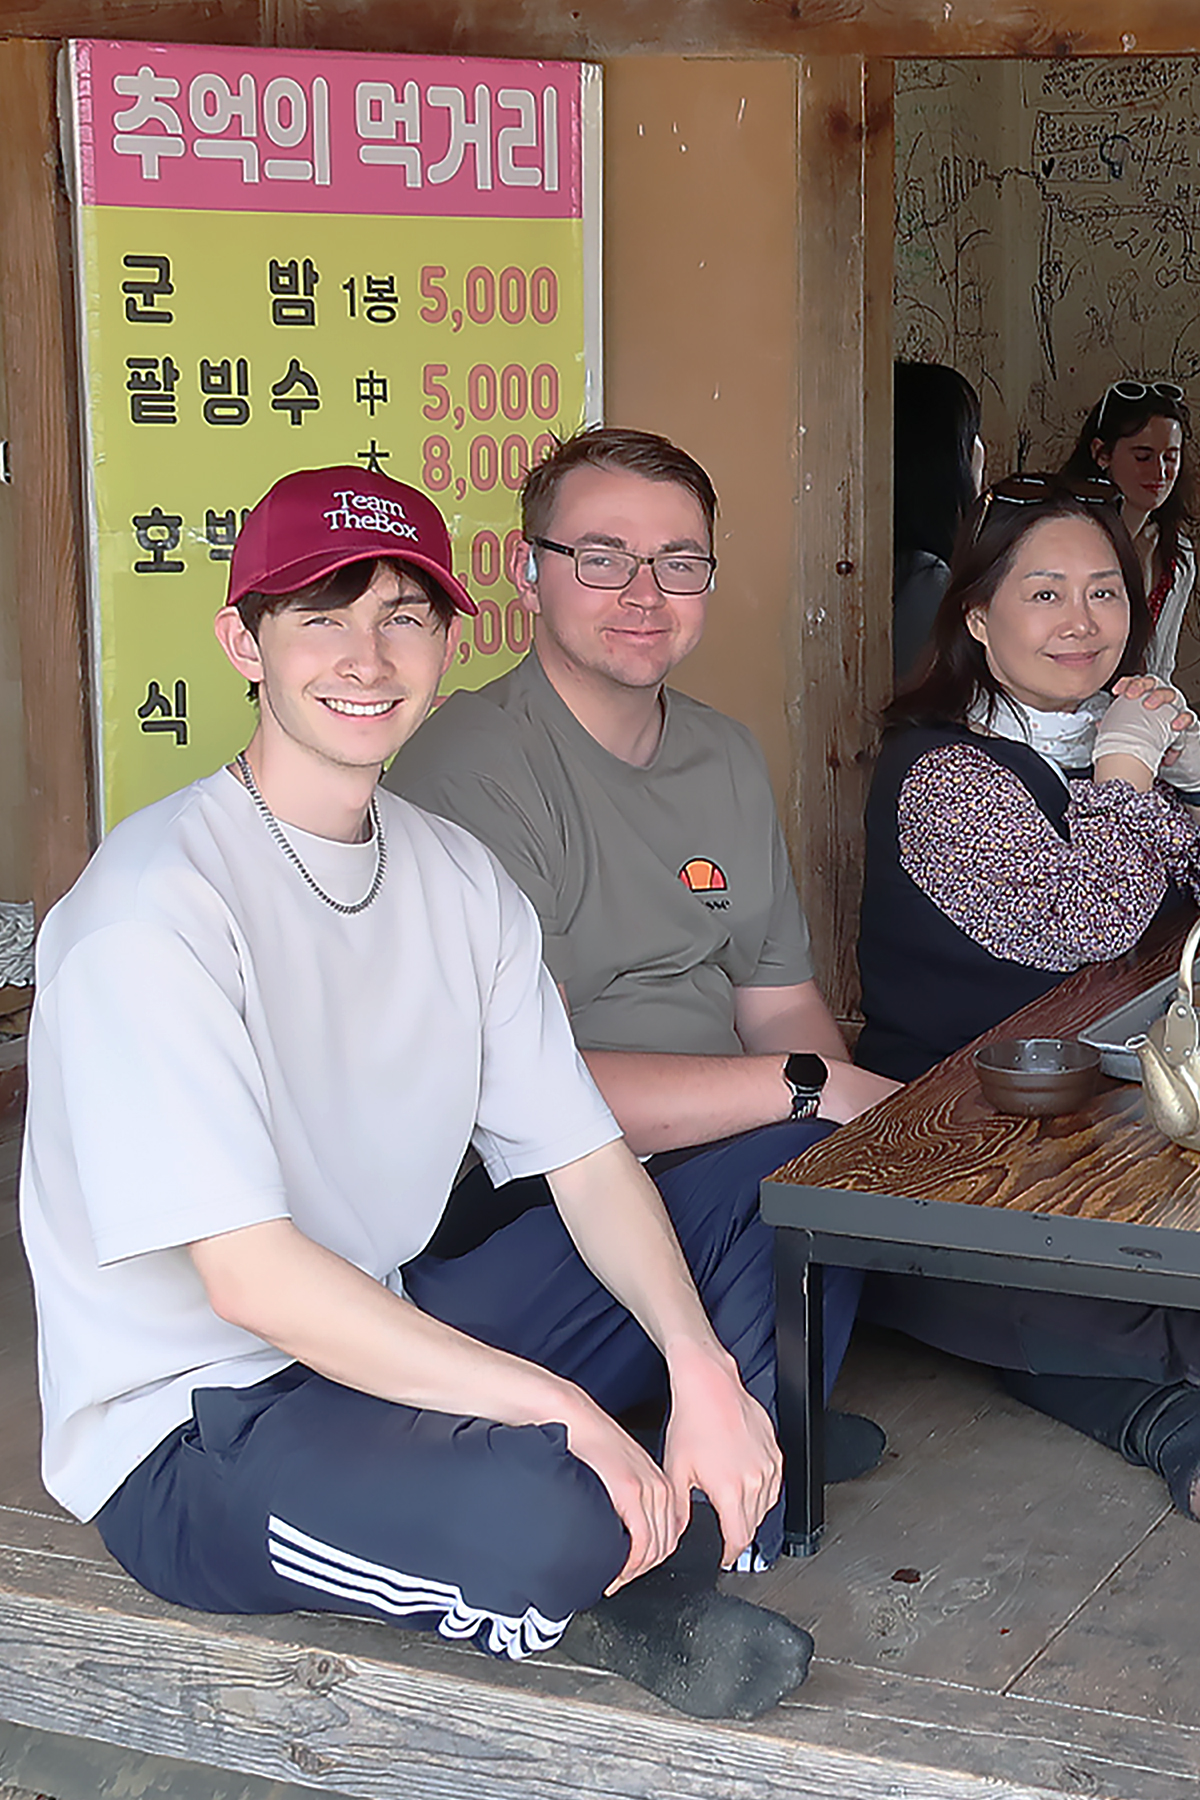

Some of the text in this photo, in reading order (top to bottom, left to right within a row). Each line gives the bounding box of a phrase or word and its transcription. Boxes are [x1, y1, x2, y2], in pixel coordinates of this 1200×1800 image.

[113, 66, 559, 192] 추억의 먹거리
[340, 275, 399, 324] 1봉
[420, 265, 559, 333] 5,000
[422, 363, 559, 430] 5,000
[323, 509, 420, 542] TheBox
[333, 490, 406, 519] Team
